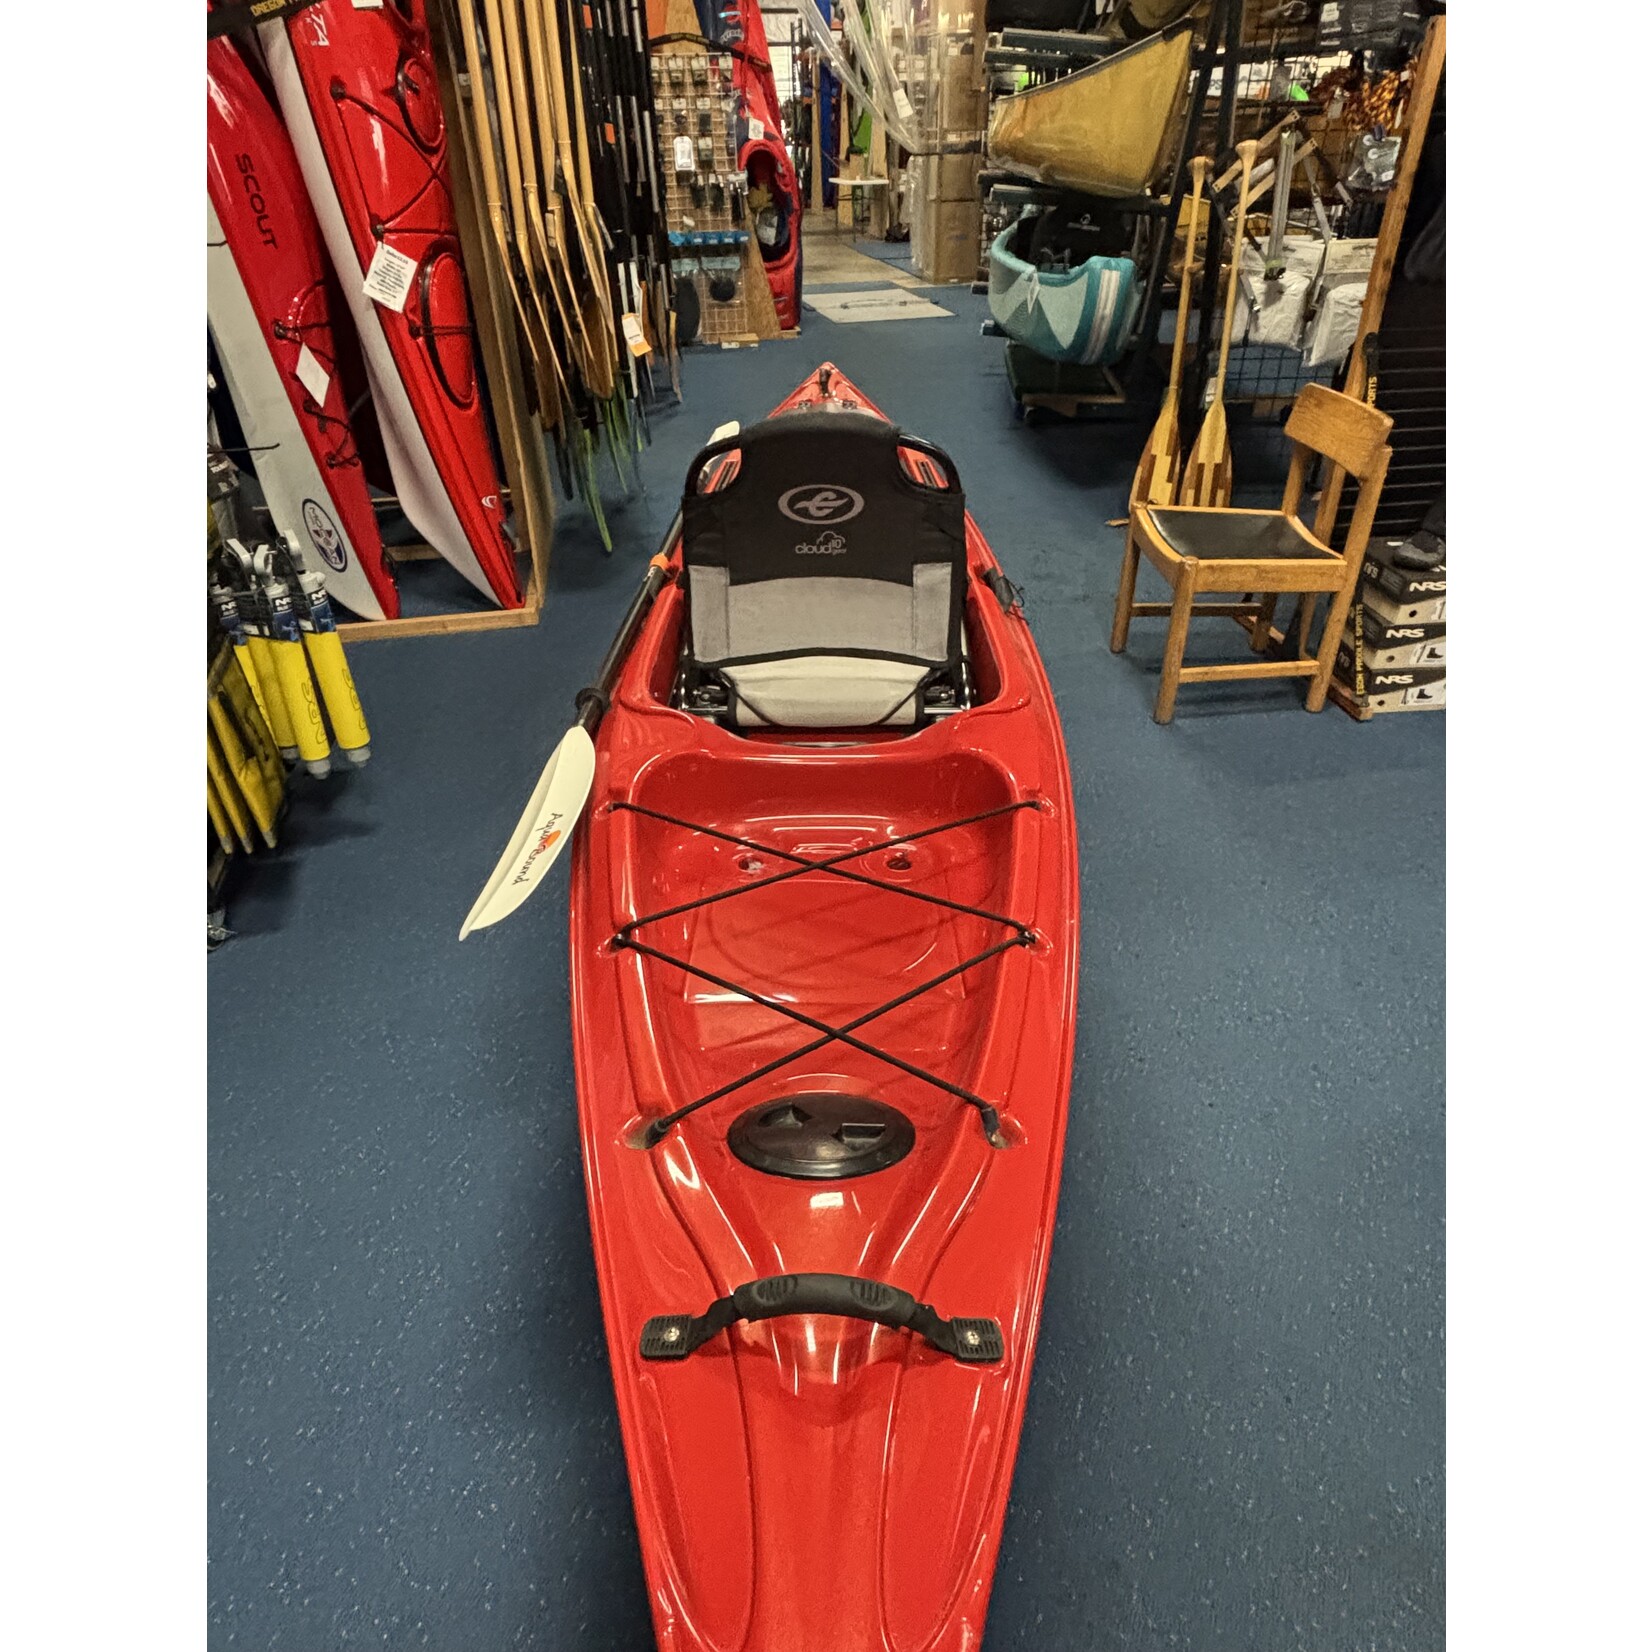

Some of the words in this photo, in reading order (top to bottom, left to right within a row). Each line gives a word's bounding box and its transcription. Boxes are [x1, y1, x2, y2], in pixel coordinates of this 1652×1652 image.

[235, 153, 278, 249] SCOUT
[1385, 628, 1425, 639] NRS
[1375, 674, 1414, 685] NRS
